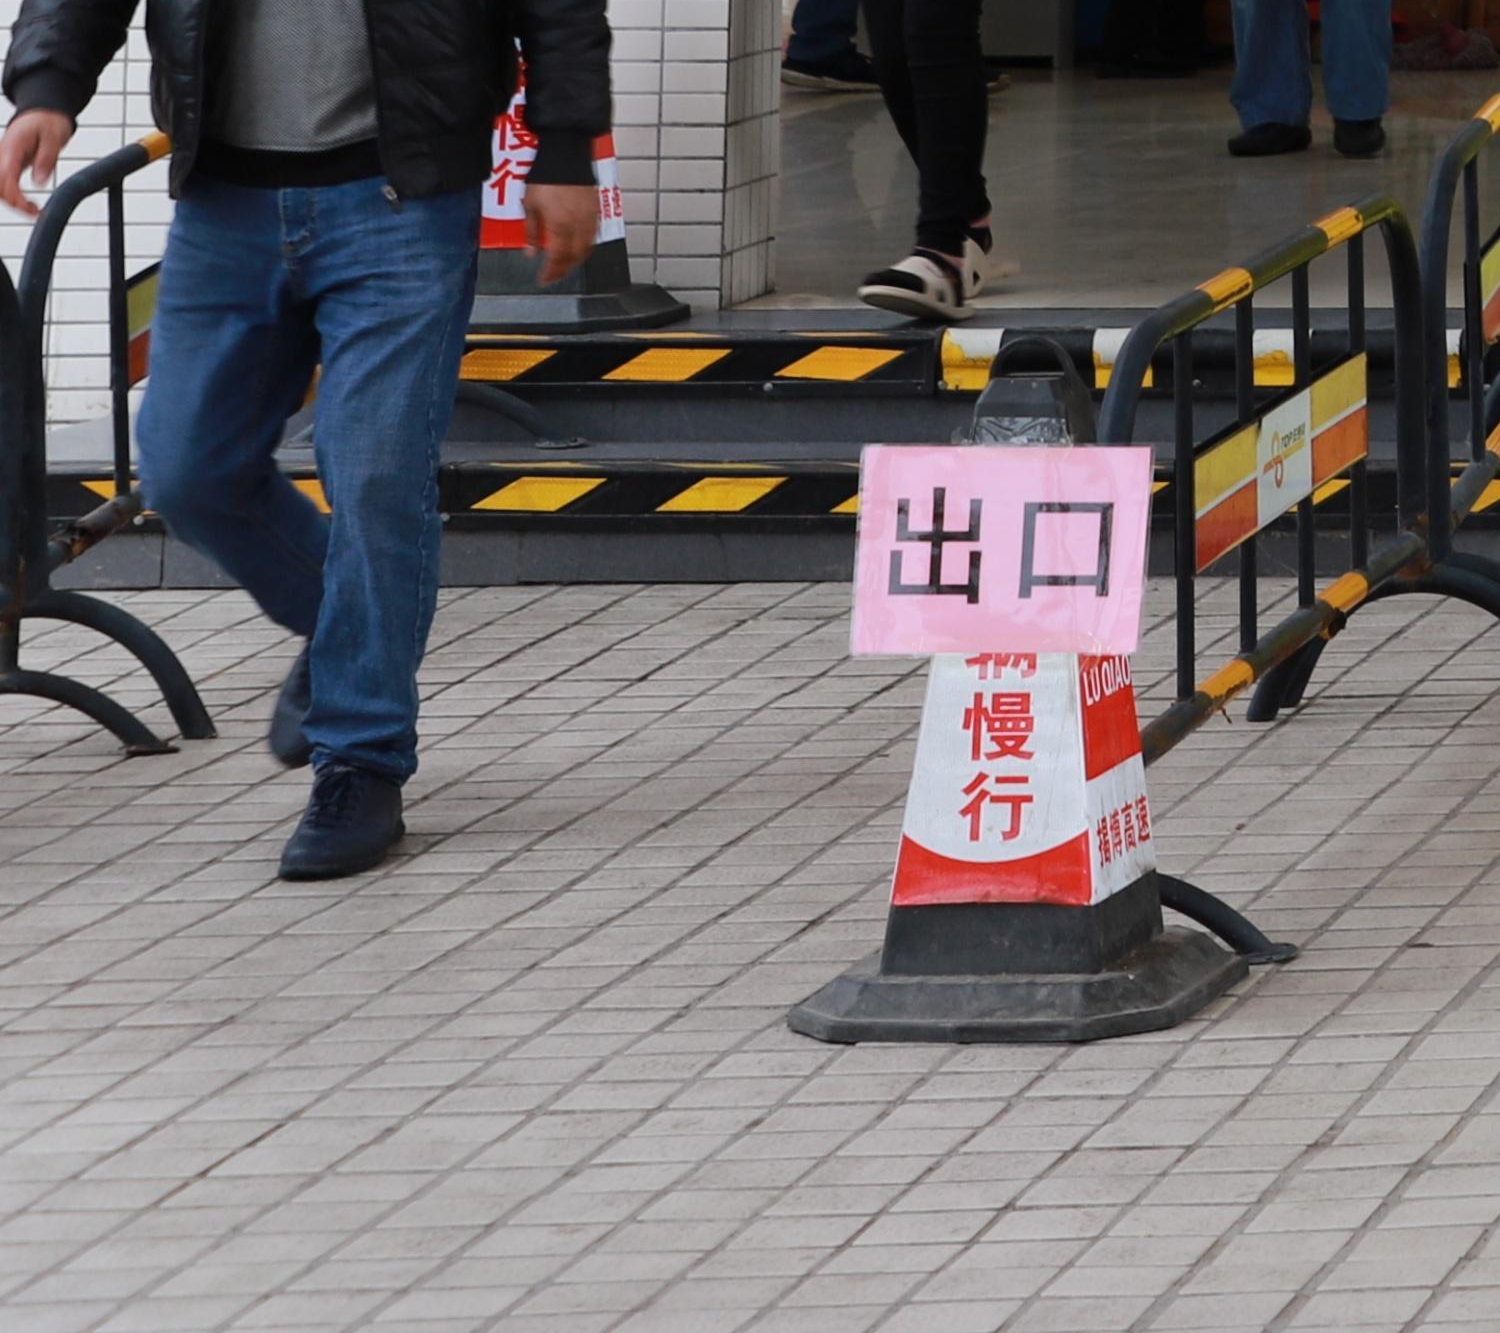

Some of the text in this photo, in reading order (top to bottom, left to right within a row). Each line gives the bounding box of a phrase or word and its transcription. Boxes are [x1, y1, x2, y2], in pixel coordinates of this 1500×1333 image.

[489, 104, 539, 206] 慢行
[887, 486, 1115, 604] 出口
[1083, 655, 1132, 707] LU QIAO
[1096, 794, 1151, 869] 揭博高速
